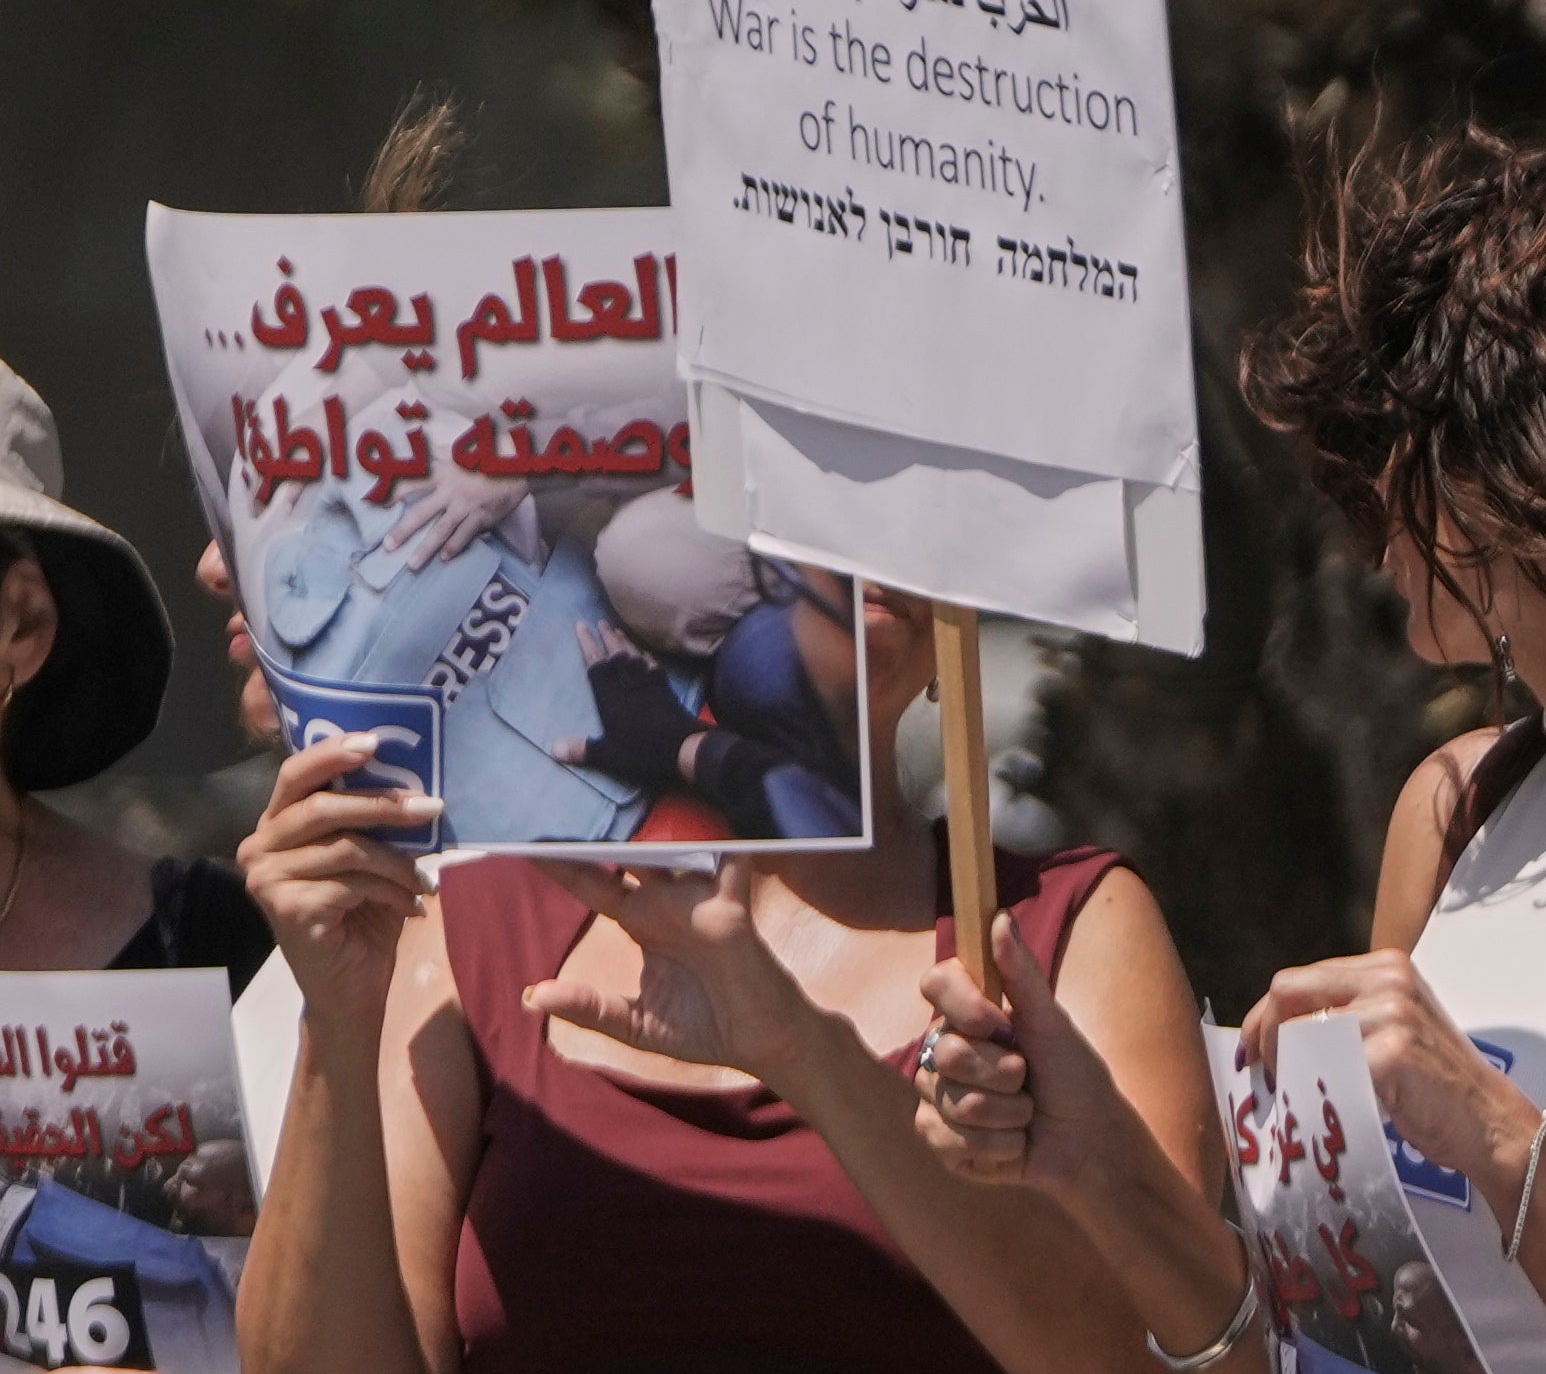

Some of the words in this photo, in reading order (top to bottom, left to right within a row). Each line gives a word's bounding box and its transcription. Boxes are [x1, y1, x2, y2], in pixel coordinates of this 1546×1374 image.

[792, 8, 818, 65] is
[829, 18, 892, 83] the
[906, 36, 1139, 136] destruction
[800, 101, 839, 153] of
[849, 105, 1046, 213] humanity.
[733, 171, 866, 241] לאנושות.
[879, 207, 970, 267] חורבן
[997, 235, 1138, 303] המלחמה
[421, 581, 531, 703] RESS
[36, 1019, 136, 1093] قتلوا
[0, 1104, 102, 1171] الحقي
[114, 1101, 194, 1169] لكن
[1312, 1077, 1347, 1203] في
[1319, 1216, 1380, 1319] كل
